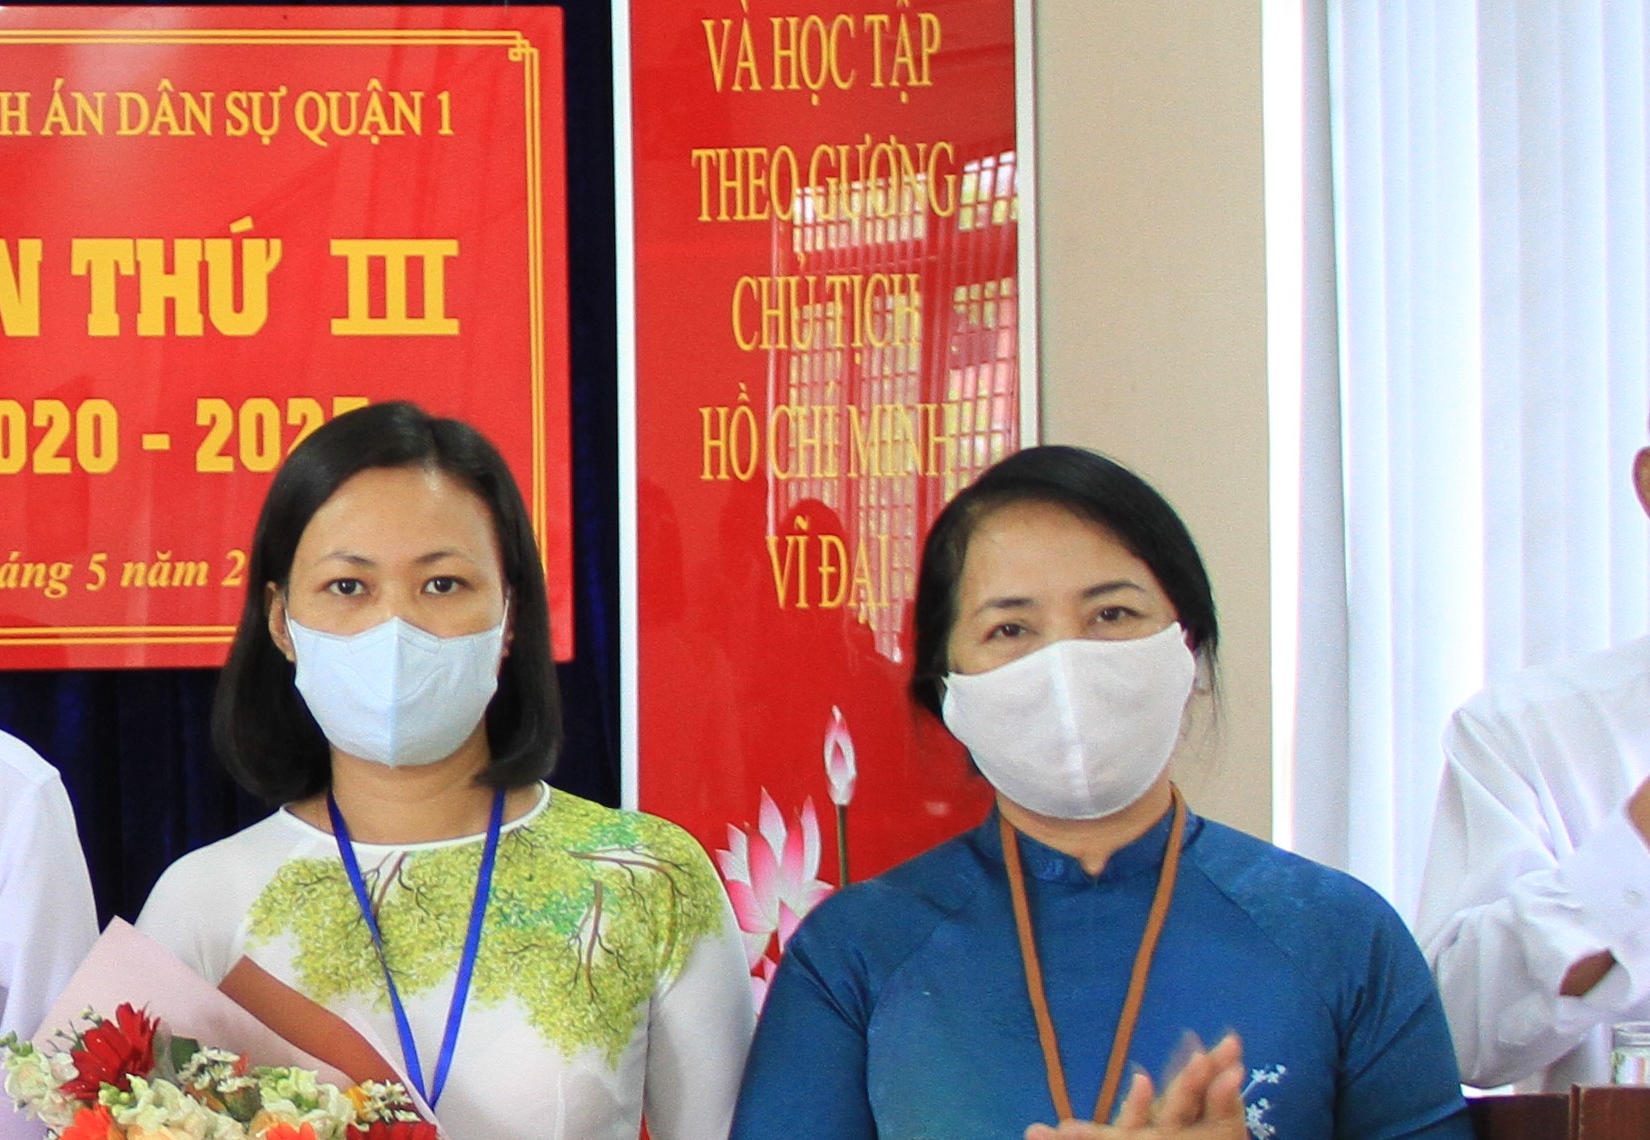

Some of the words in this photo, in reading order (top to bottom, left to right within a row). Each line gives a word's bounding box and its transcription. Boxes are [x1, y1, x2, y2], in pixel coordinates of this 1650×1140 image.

[701, 0, 762, 92] VÀ
[770, 14, 856, 106] HỌC
[864, 0, 942, 104] TẬP
[40, 78, 107, 137] ÁN
[116, 78, 214, 137] DÂN
[225, 86, 288, 145] SỰ
[294, 78, 424, 147] QUẬN
[438, 91, 453, 136] 1
[692, 145, 799, 222] THEO
[808, 133, 957, 220] GƯƠNG
[70, 217, 283, 337] THỨ
[329, 239, 460, 337] III
[732, 252, 817, 351] CHỦ
[825, 273, 921, 365] TỊCH
[142, 433, 171, 451] -
[196, 396, 370, 473] 202
[699, 382, 758, 481] HỒ
[769, 381, 840, 480] CHÍ
[847, 402, 958, 478] MINH
[86, 553, 108, 591] 5
[121, 553, 210, 588] năm
[765, 515, 810, 609] VĨ
[818, 534, 890, 624] ĐẠI
